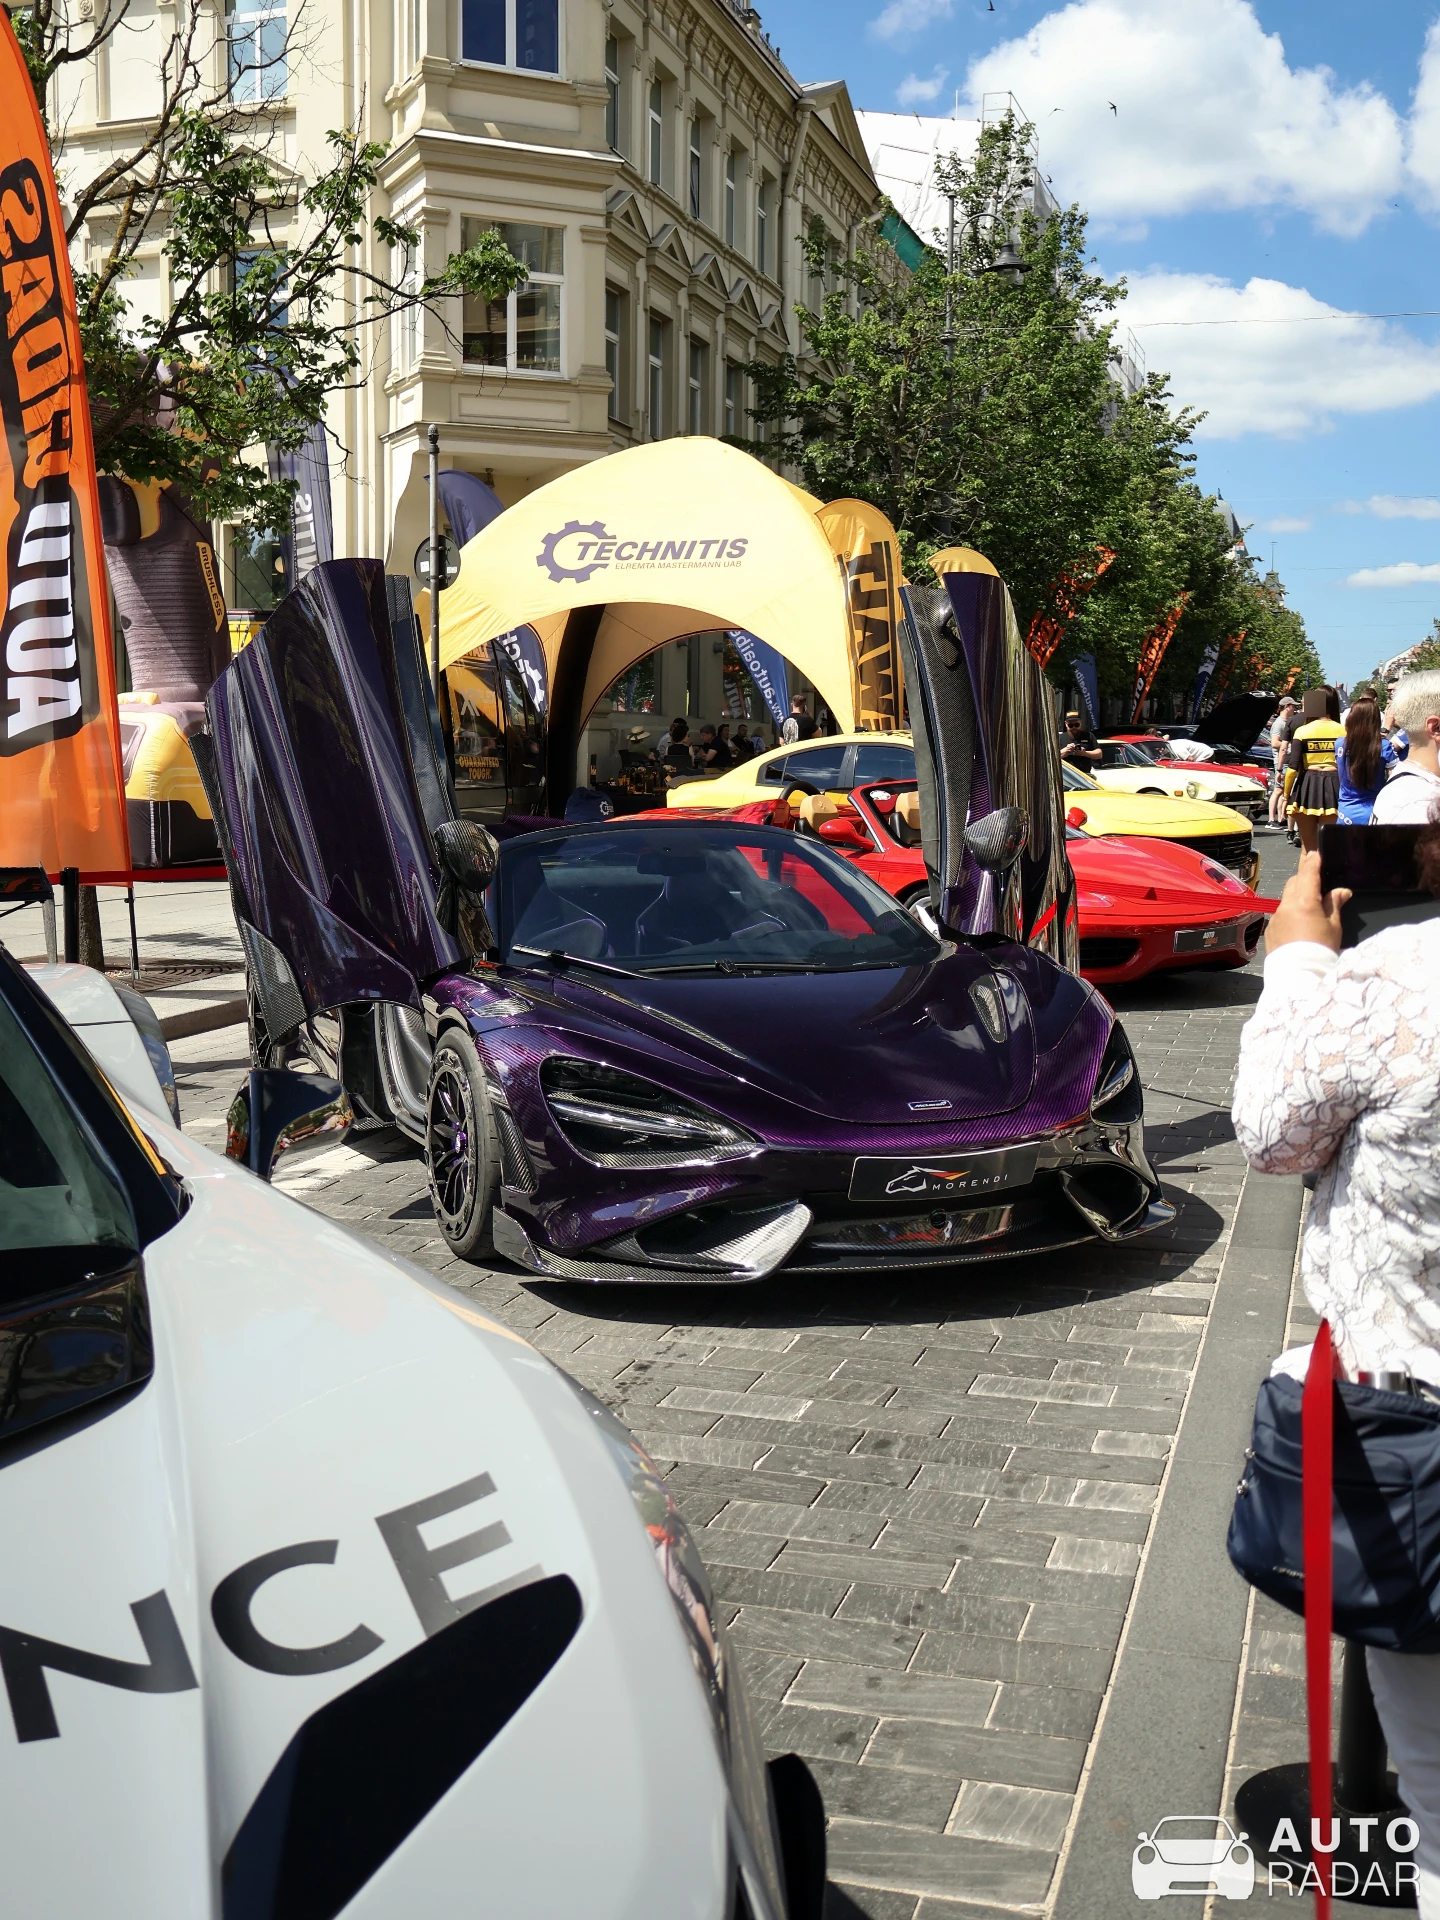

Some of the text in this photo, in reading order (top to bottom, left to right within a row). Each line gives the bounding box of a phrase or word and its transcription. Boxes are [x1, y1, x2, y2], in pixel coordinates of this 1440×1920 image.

[577, 538, 749, 561] TECHNITIS
[615, 560, 742, 570] ELREMTA MASTERMANN UAB
[201, 546, 222, 616] BRUSHLESS
[459, 756, 499, 768] GUARANTEED
[932, 1174, 1008, 1191] MORENDI
